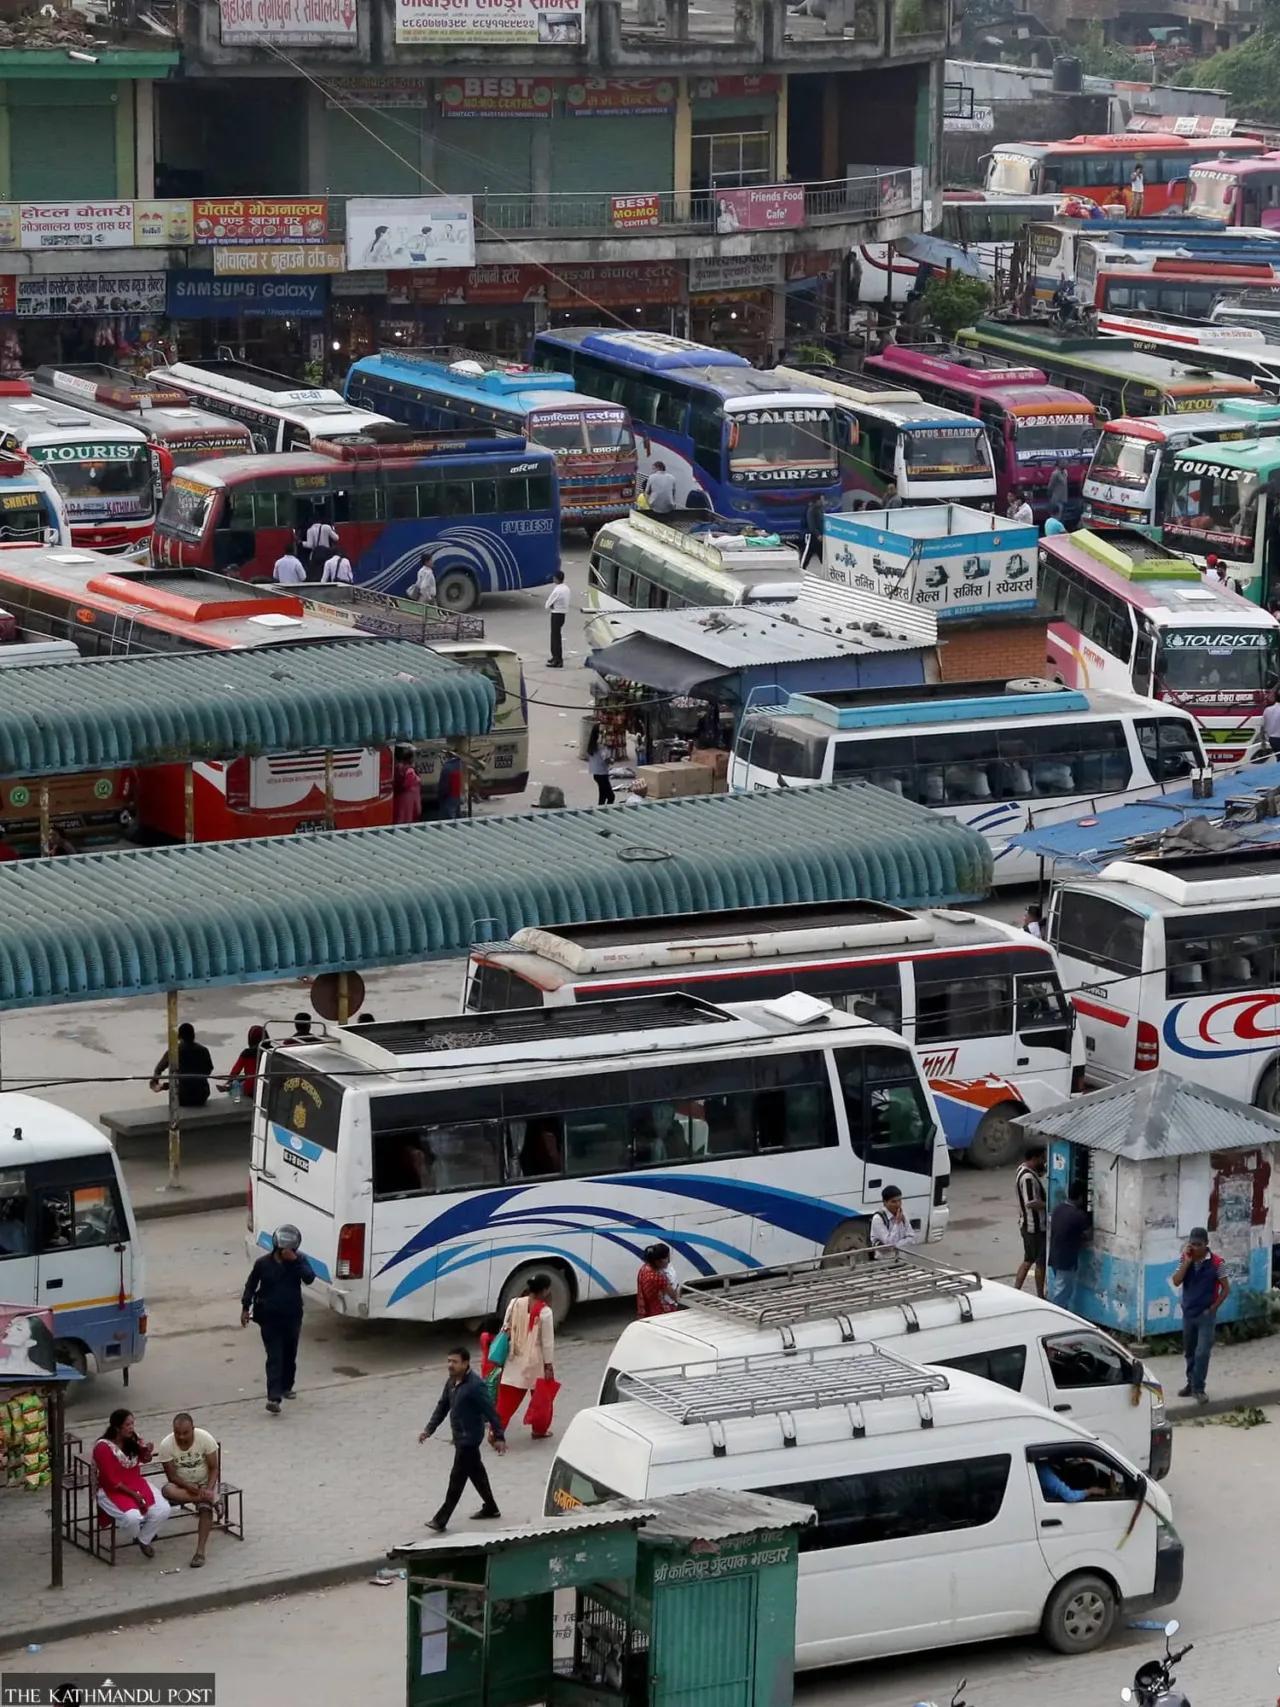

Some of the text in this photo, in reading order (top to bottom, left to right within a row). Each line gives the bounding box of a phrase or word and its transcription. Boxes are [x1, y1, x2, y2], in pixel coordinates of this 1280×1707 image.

[464, 77, 535, 97] BEST
[993, 153, 1038, 165] TOURIST
[1188, 169, 1237, 182] TOURIST
[751, 190, 803, 203] Friends Food
[198, 202, 324, 217] चौतारी भोजनालय
[614, 198, 655, 209] BEST
[21, 207, 69, 219] होटल
[613, 208, 659, 219] MO:MO:
[21, 221, 70, 233] भोजनालय
[118, 221, 132, 231] घर
[219, 217, 302, 226] एण्ड खाजा घर
[623, 219, 649, 228] CENTER
[176, 281, 255, 296] SAMSUNG
[262, 282, 318, 301] Galaxy
[539, 411, 580, 422] कालिका
[746, 409, 831, 425] SALEENA
[909, 428, 982, 439] LOTUS TRAVELS
[207, 438, 247, 449] YATAYAT
[42, 444, 142, 461] TOURIST
[743, 469, 832, 482] TOURIST
[1172, 459, 1257, 485] TOURIST
[4, 492, 38, 510] SHREYA
[502, 518, 553, 534] EVEREST
[828, 567, 846, 583] सेल्स
[915, 588, 940, 603] सेल्स
[1183, 634, 1259, 647] TOURIST
[654, 1564, 668, 1583] श्री
[751, 1546, 790, 1566] भण्डार
